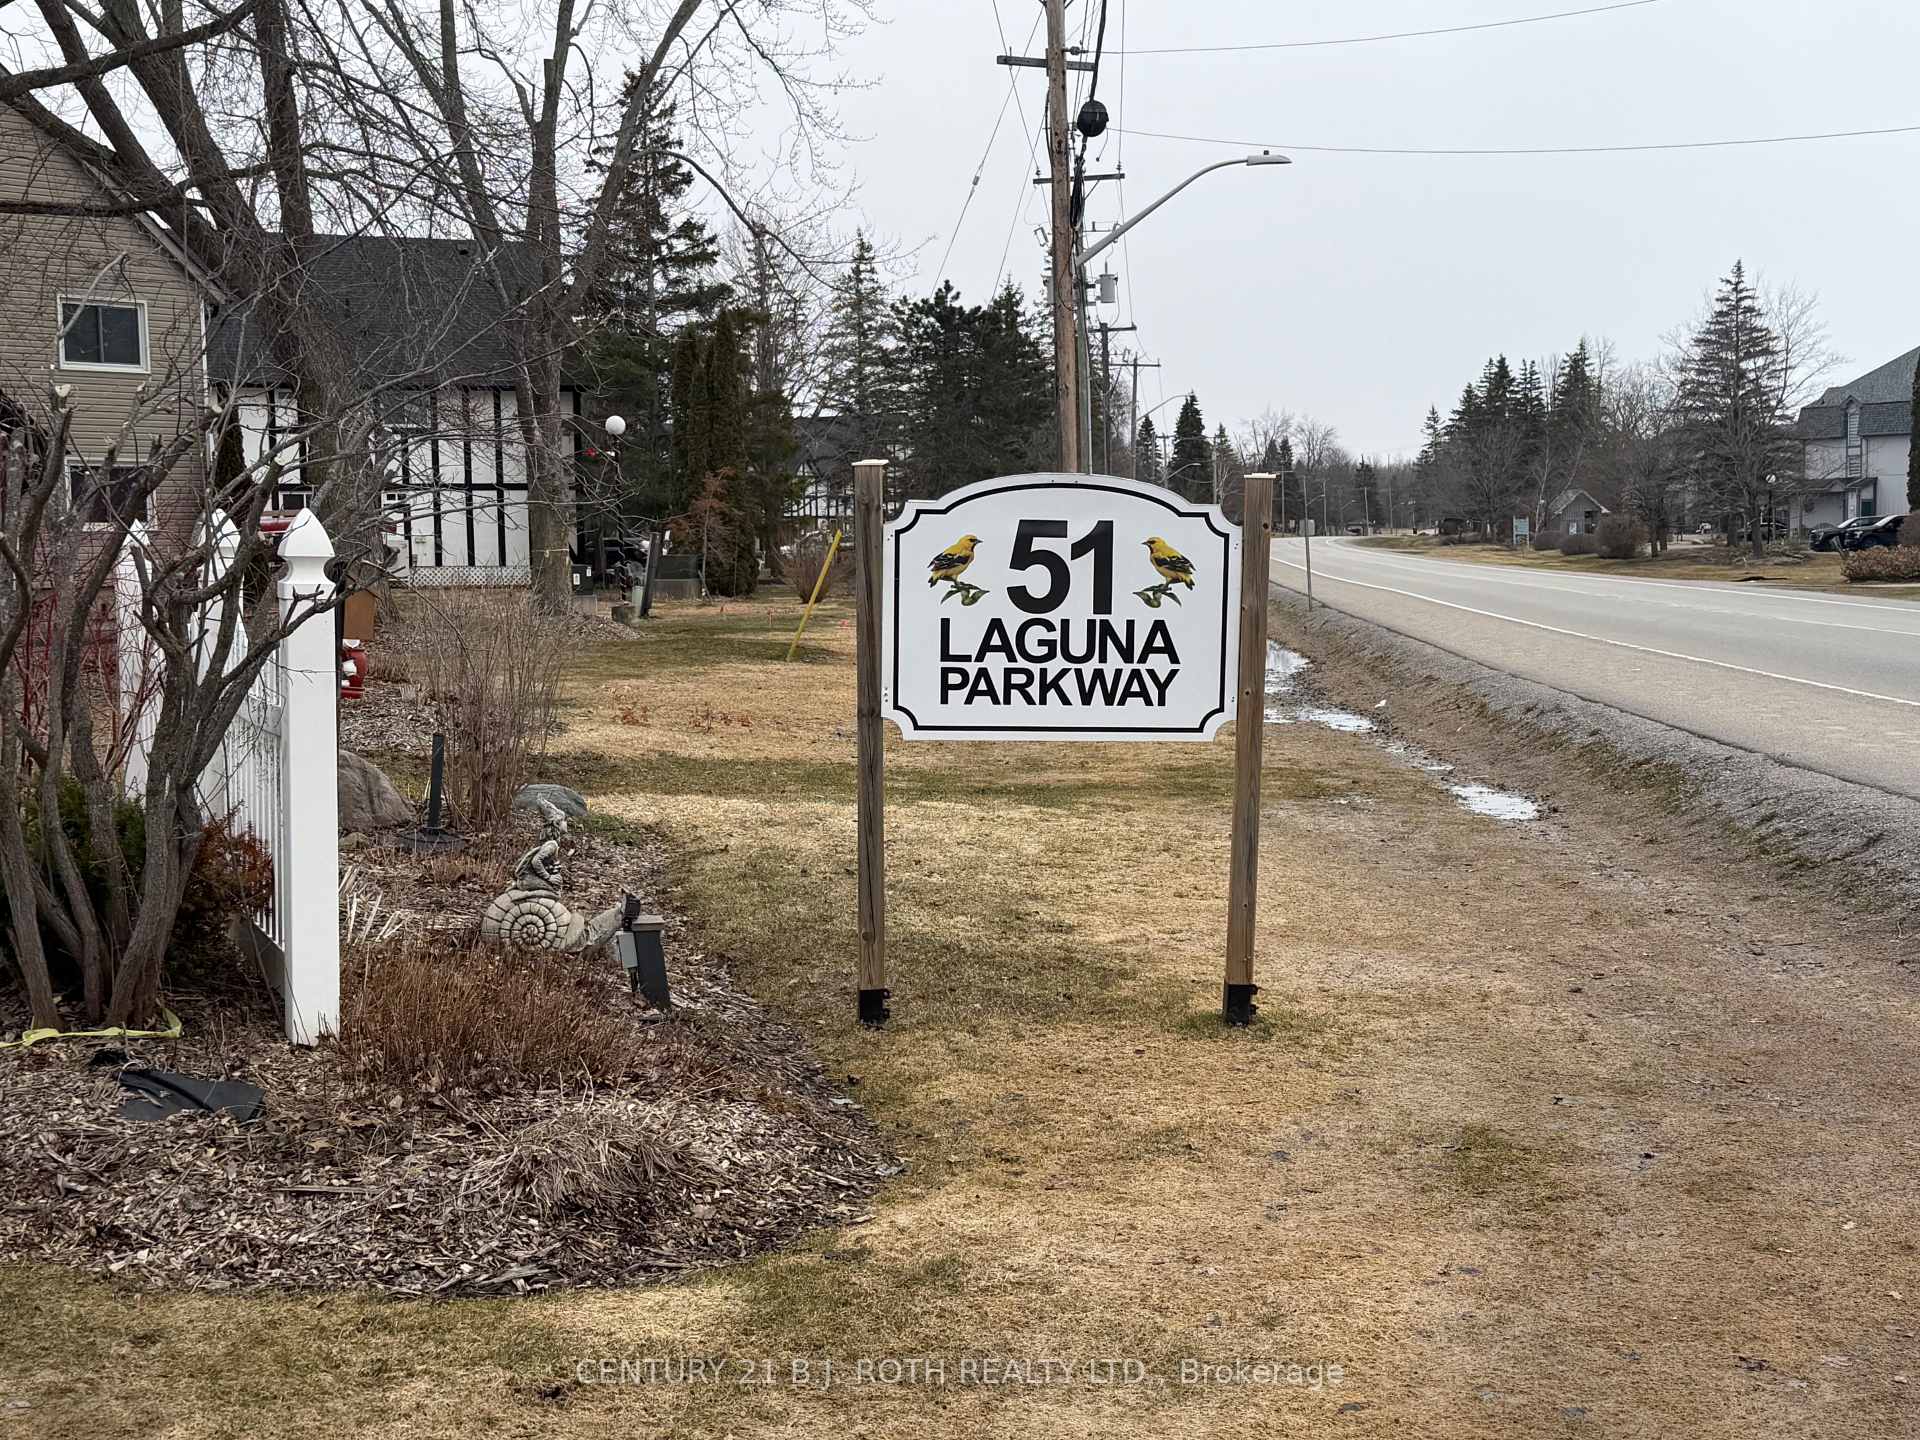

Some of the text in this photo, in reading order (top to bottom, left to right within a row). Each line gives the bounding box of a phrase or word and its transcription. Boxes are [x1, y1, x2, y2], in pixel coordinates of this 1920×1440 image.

[1006, 519, 1114, 616] 51
[939, 616, 1181, 665] LAGUNA
[938, 666, 1181, 707] PARKWAY
